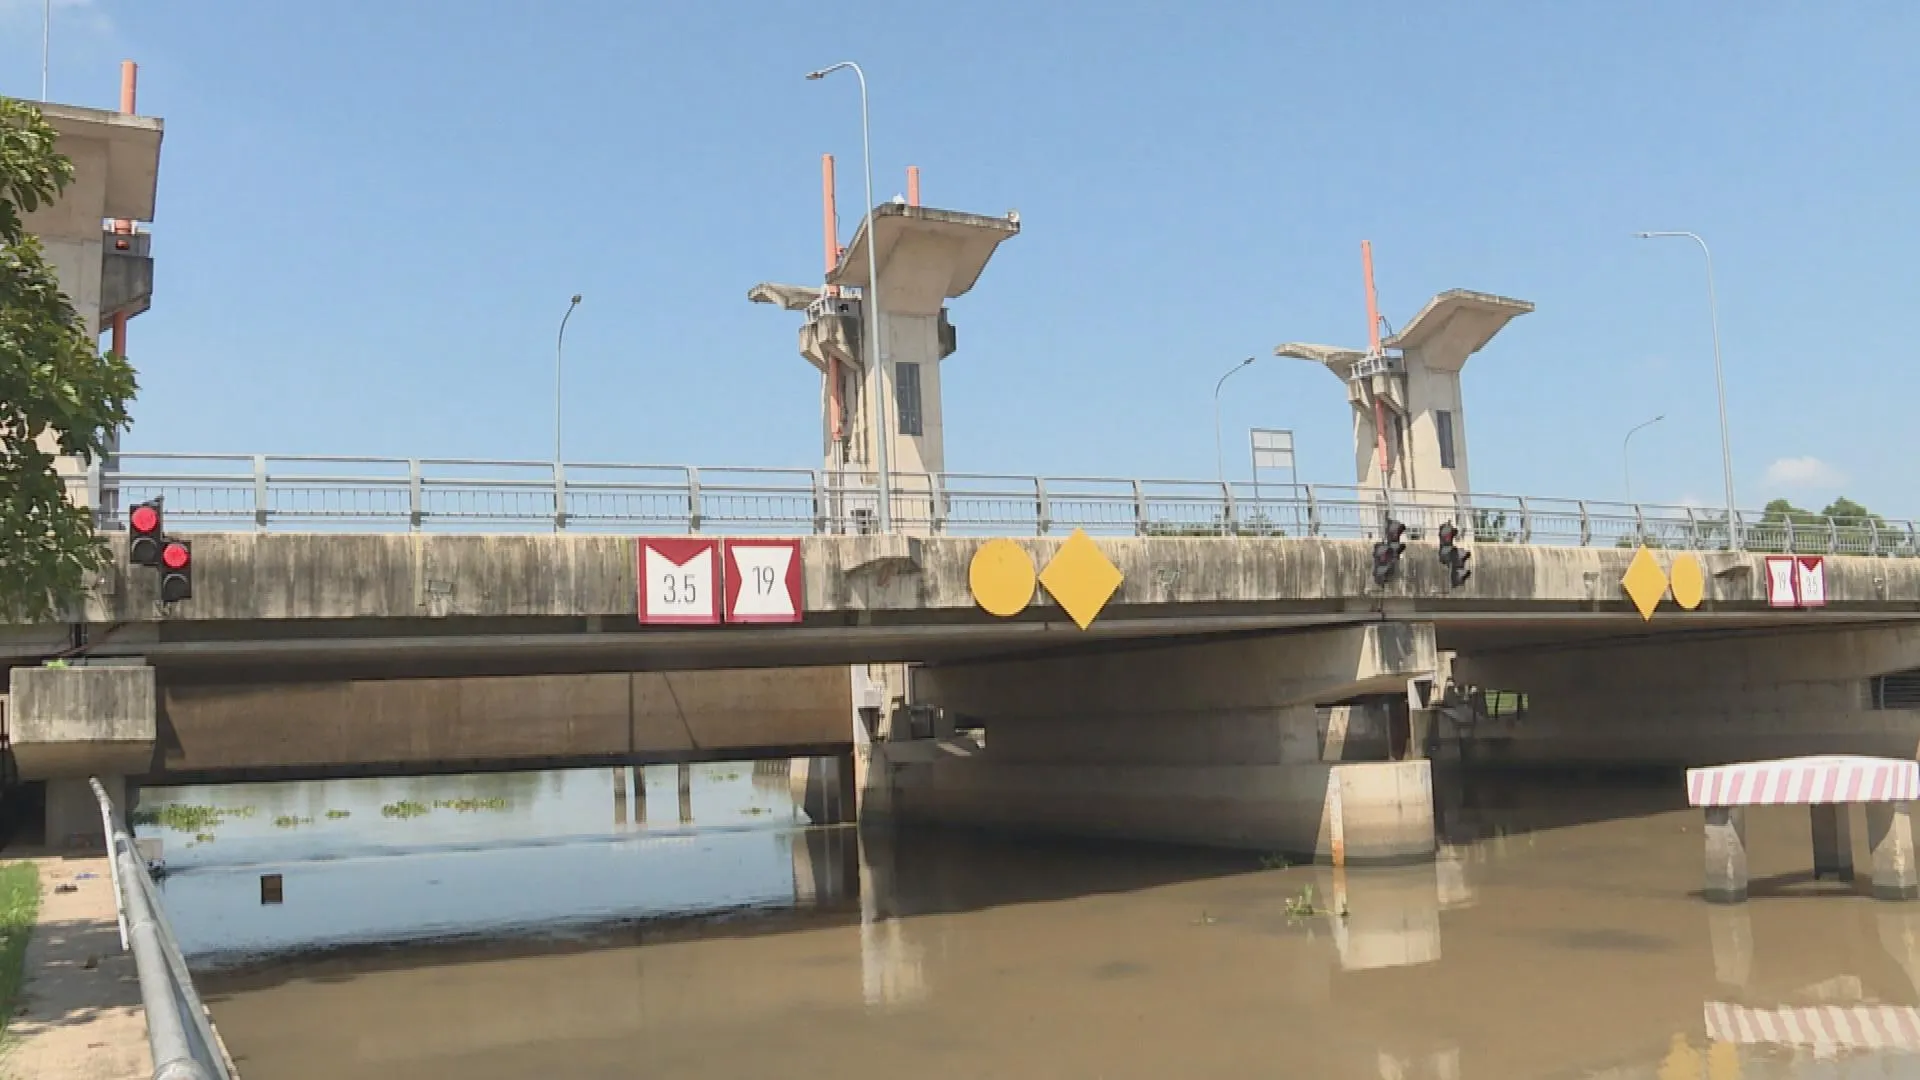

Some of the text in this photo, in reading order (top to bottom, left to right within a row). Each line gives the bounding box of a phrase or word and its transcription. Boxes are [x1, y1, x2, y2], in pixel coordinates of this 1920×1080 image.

[663, 573, 697, 605] 3.5
[751, 565, 775, 596] 19
[1777, 571, 1787, 591] 19
